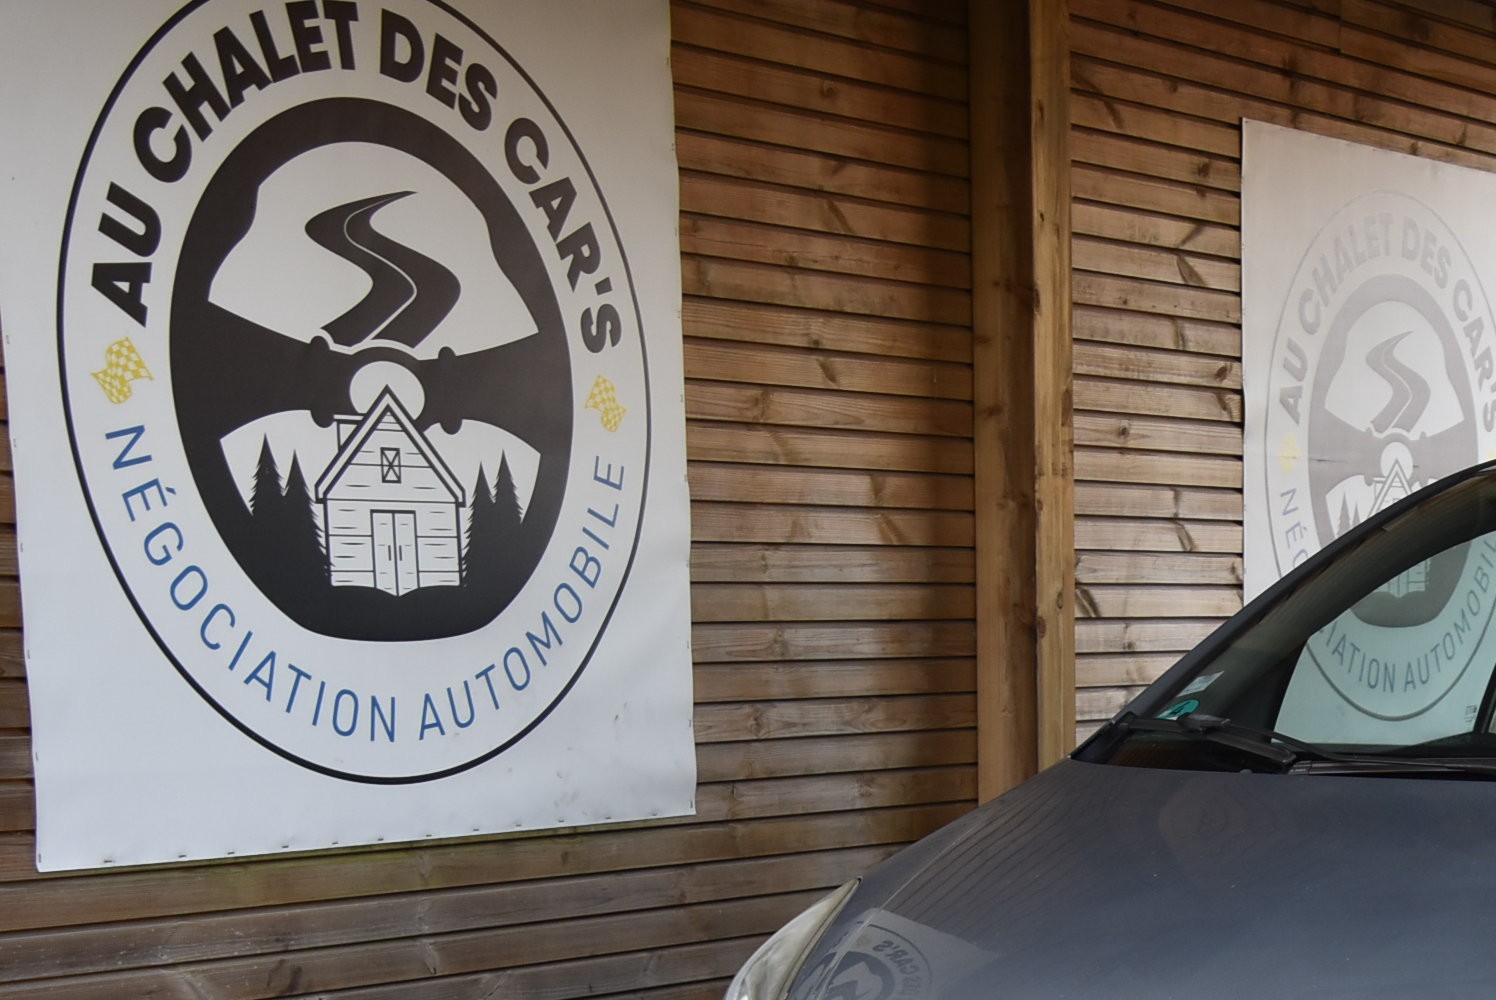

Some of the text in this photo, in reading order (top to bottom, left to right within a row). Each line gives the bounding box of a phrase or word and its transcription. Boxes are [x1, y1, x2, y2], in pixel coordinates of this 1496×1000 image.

[91, 0, 622, 354] AU CHALET DES CAR'S
[1279, 338, 1308, 427] AU
[1300, 212, 1394, 337] CHALET
[1401, 211, 1451, 290] DES
[105, 424, 625, 742] NÉGOCIATION AUTOMOBILE
